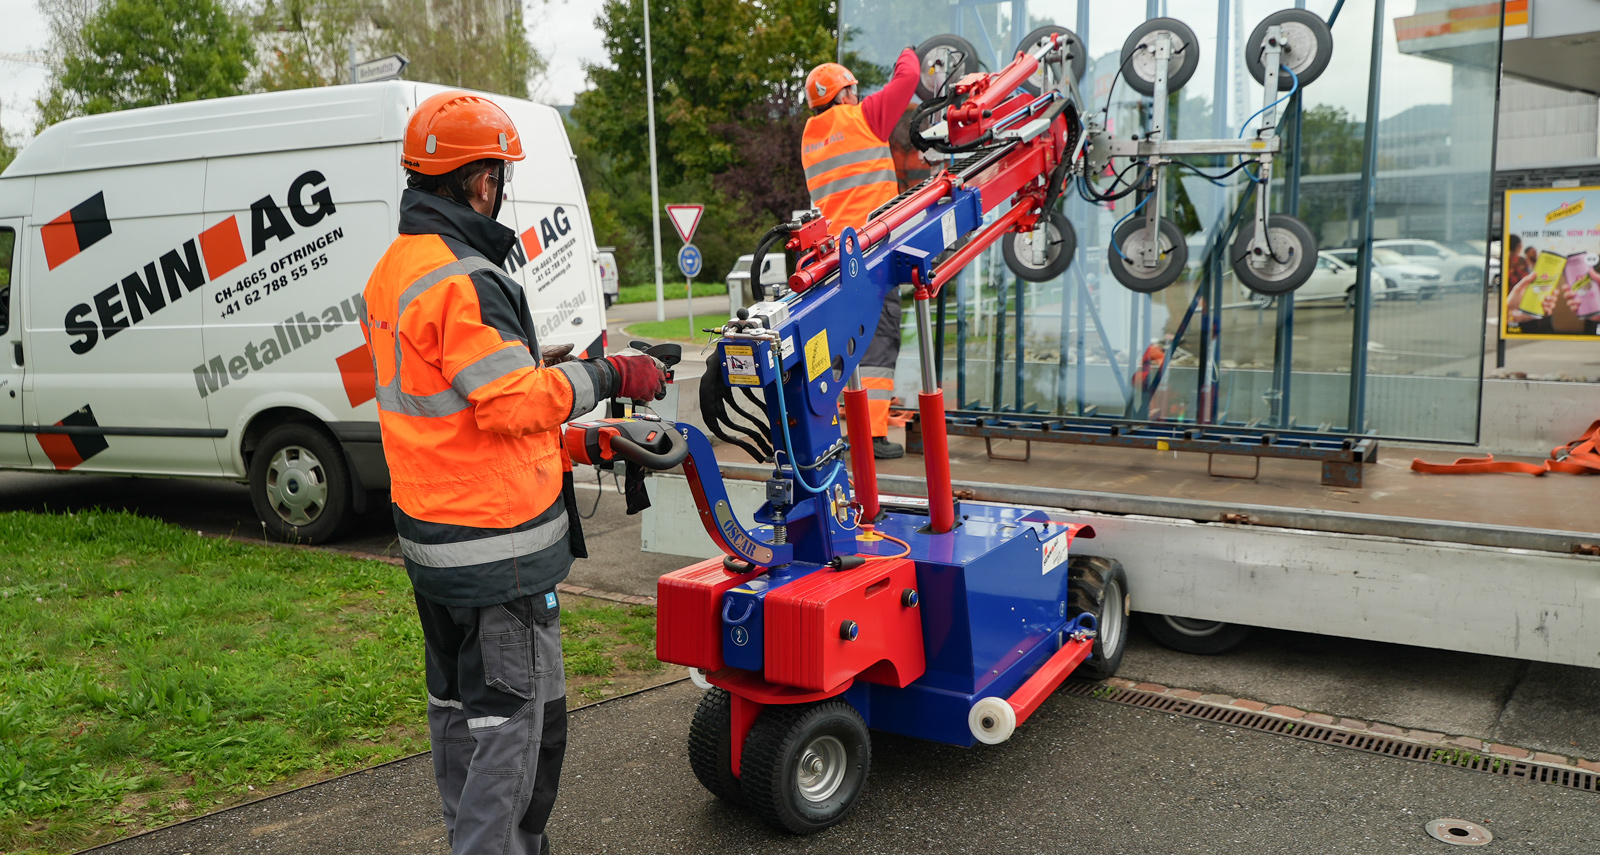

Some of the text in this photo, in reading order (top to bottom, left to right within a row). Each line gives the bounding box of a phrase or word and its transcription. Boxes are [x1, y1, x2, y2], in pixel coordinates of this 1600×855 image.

[804, 132, 844, 154] ENN AG
[540, 206, 571, 250] AG
[1521, 230, 1538, 238] YOUR
[1566, 229, 1584, 237] NOW
[64, 170, 337, 355] SENN AG
[214, 227, 344, 304] CH-4665 OFTRINGEN
[220, 253, 328, 319] +41 62 788 55 55
[193, 293, 362, 399] Metallbau
[724, 520, 757, 557] OSCAR
